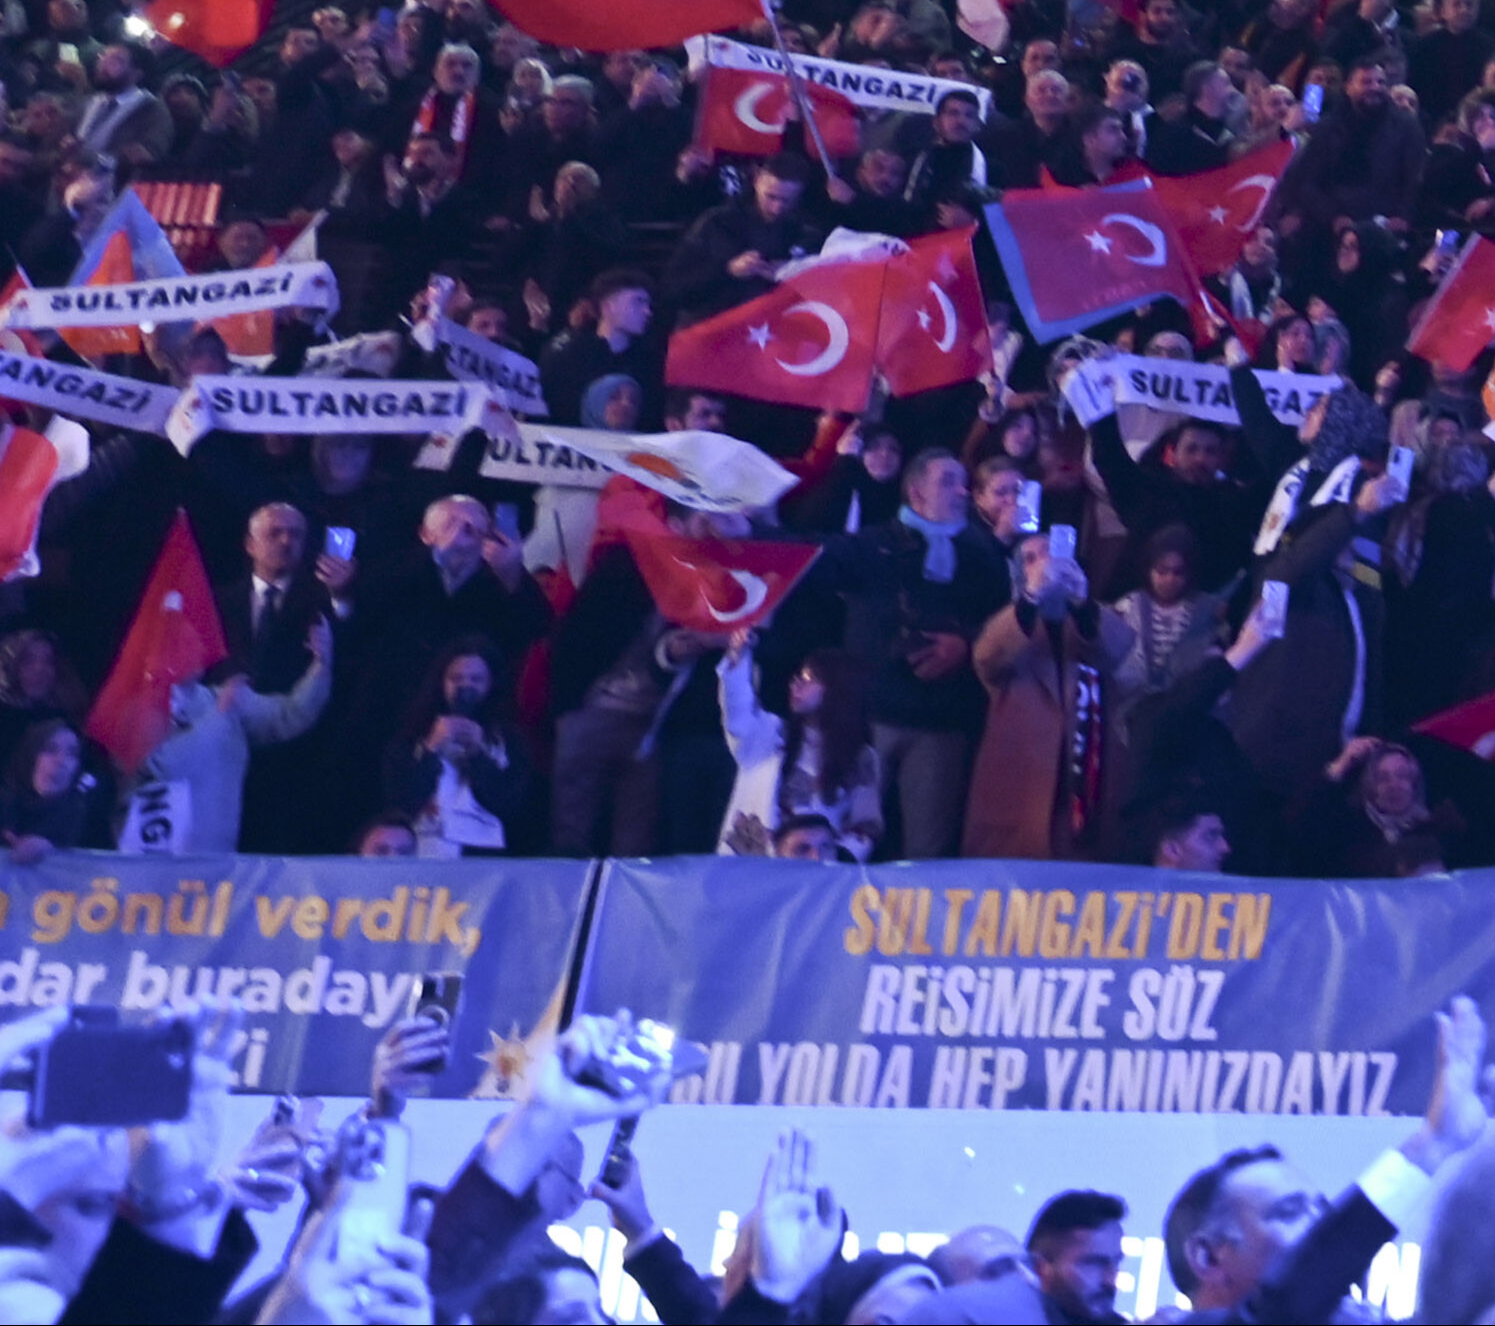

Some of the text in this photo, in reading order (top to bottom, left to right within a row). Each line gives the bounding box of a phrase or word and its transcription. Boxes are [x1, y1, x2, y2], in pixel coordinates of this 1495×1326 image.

[746, 51, 937, 103] UTANGAZİ
[49, 271, 295, 312] SULTANGAZİ
[0, 353, 153, 413] ANGAZİ
[212, 387, 467, 417] SULTANGAZİ
[1130, 369, 1326, 415] SULTAGA
[488, 438, 613, 474] ULTAN
[31, 877, 234, 943] gönül
[255, 885, 481, 958] verdik,
[844, 884, 1272, 961] SULTANGAZİ'DEN
[121, 949, 412, 1029] buraday
[1122, 963, 1226, 1041] SÖZ
[758, 1041, 914, 1108] YOLDA
[927, 1045, 1029, 1111] HEP
